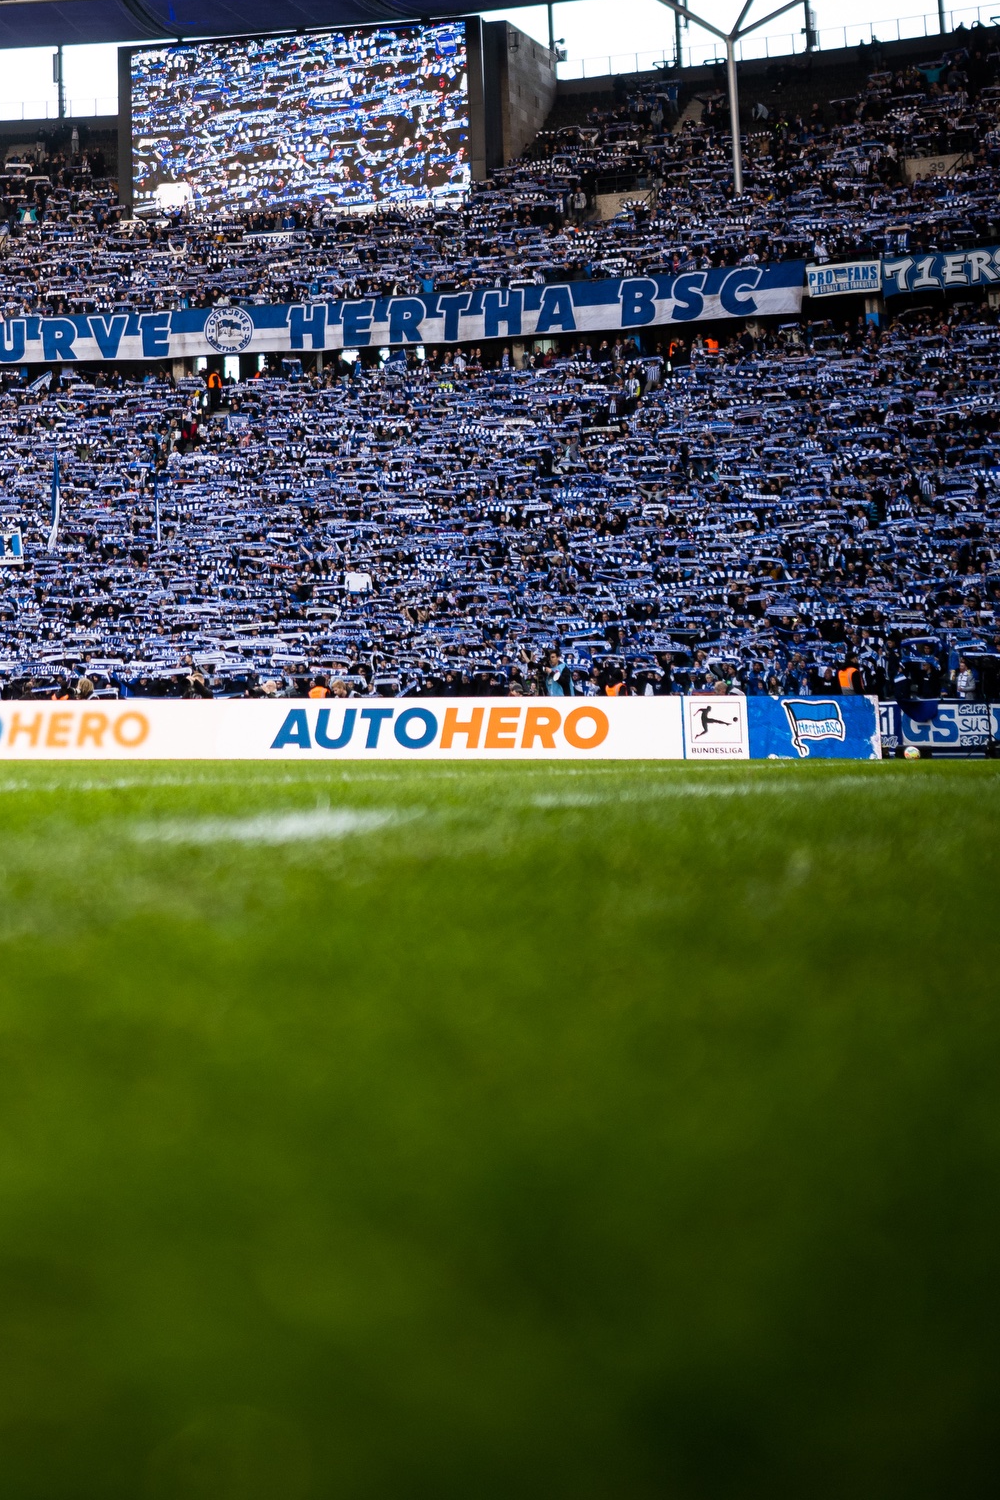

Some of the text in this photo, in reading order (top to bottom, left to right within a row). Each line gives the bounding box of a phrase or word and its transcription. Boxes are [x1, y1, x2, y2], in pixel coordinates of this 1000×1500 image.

[930, 161, 945, 172] 39
[809, 266, 877, 286] PRO FANS
[286, 284, 578, 350] HERTHA
[619, 266, 764, 328] BSC
[959, 703, 990, 714] GRUPP
[270, 706, 610, 750] AUTOHERO
[825, 721, 841, 733] BSC
